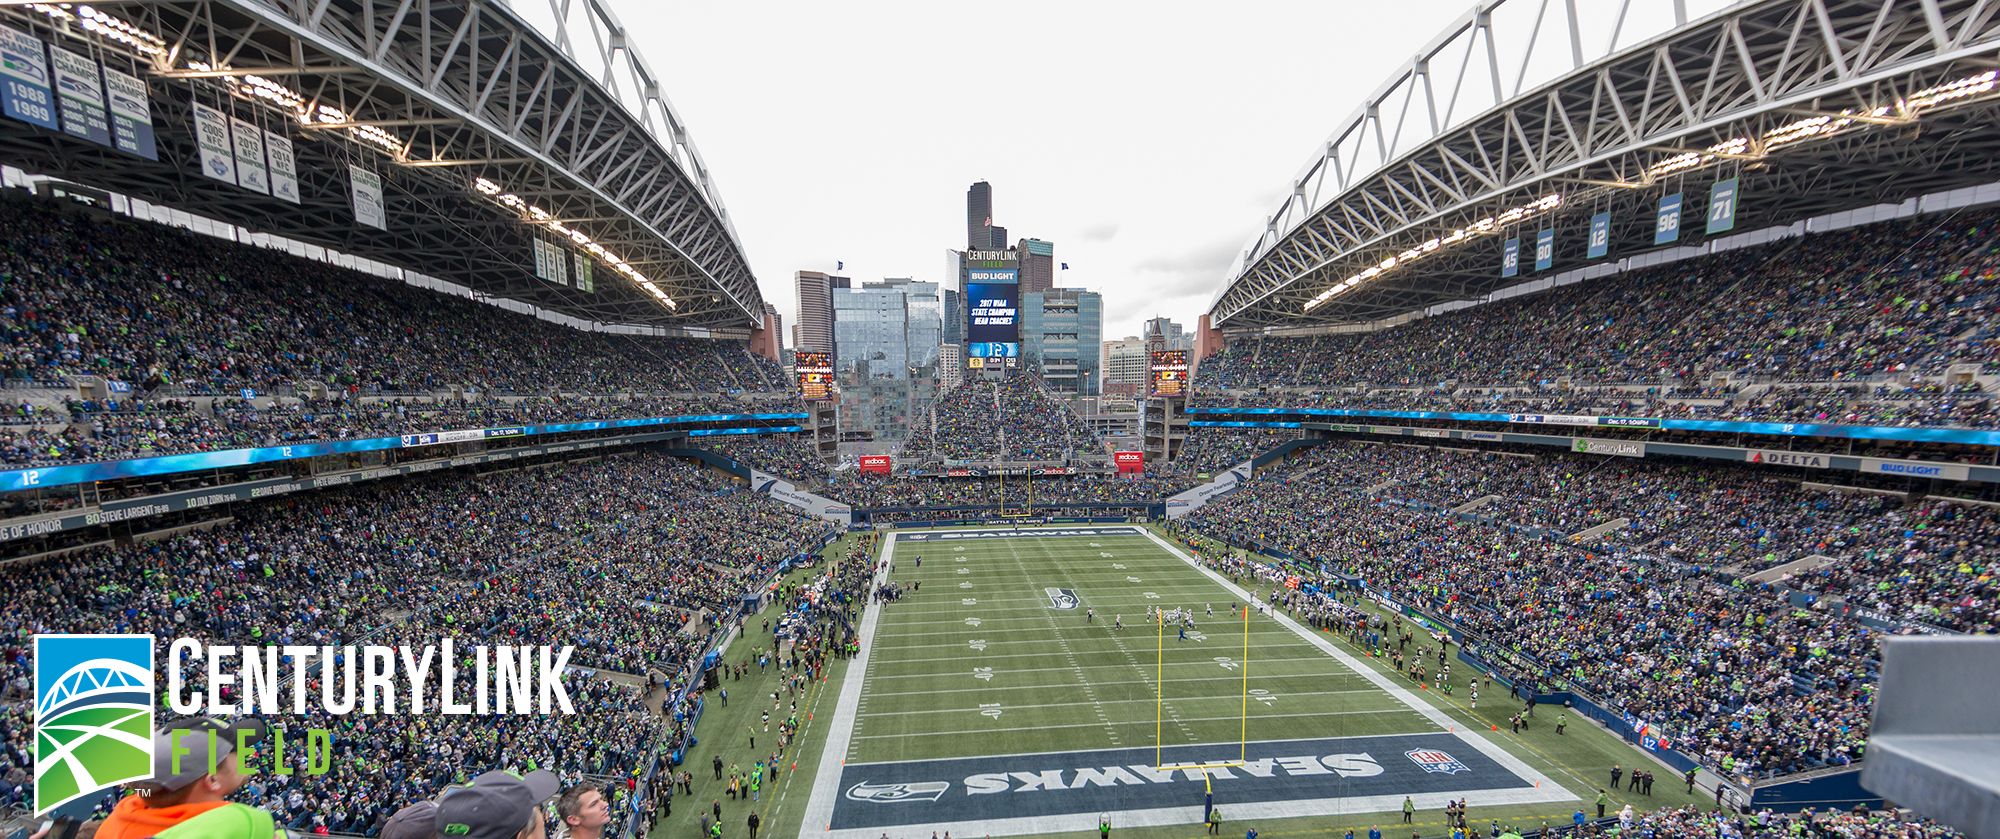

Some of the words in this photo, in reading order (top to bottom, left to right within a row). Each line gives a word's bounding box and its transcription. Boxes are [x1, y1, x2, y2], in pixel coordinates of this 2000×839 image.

[52, 47, 71, 63] NFC
[73, 54, 98, 73] WEST
[55, 60, 98, 83] CHAMPS
[106, 70, 123, 85] NFC
[124, 76, 146, 92] WEST
[8, 81, 47, 105] 1988
[108, 81, 147, 102] CHAMPS
[12, 100, 50, 121] 1999
[201, 121, 225, 139] 2005
[206, 134, 223, 148] NFC
[238, 135, 259, 153] 2013
[242, 147, 257, 161] NFC
[271, 148, 291, 164] 2014
[275, 159, 289, 172] NFC
[1712, 199, 1732, 220] 71
[1658, 212, 1679, 232] 96
[1591, 229, 1607, 247] 12
[968, 249, 1017, 261] CENTURYLINK
[1537, 244, 1552, 260] 80
[1503, 252, 1518, 268] 45
[979, 299, 992, 307] 2017
[974, 317, 989, 325] HEAD
[989, 317, 1013, 325] COACHES
[989, 343, 1002, 357] 12
[114, 381, 128, 392] 12
[244, 388, 255, 399] 12
[1783, 424, 1793, 433] 12
[282, 446, 293, 457] 12
[1588, 441, 1638, 454] CenturyLink
[1768, 453, 1822, 467] DELTA
[1880, 463, 1905, 472] BUD
[1906, 466, 1941, 476] LIGHT
[22, 471, 39, 485] 12
[251, 488, 260, 497] 22
[186, 499, 197, 508] 10
[85, 513, 100, 525] 80
[100, 509, 124, 523] STEVE
[124, 505, 154, 519] LARGENT
[11, 525, 25, 538] OF
[28, 520, 63, 535] HONOR
[1644, 737, 1656, 749] 12
[1410, 750, 1452, 764] NFL
[963, 752, 1385, 796] SEAHAWKS
